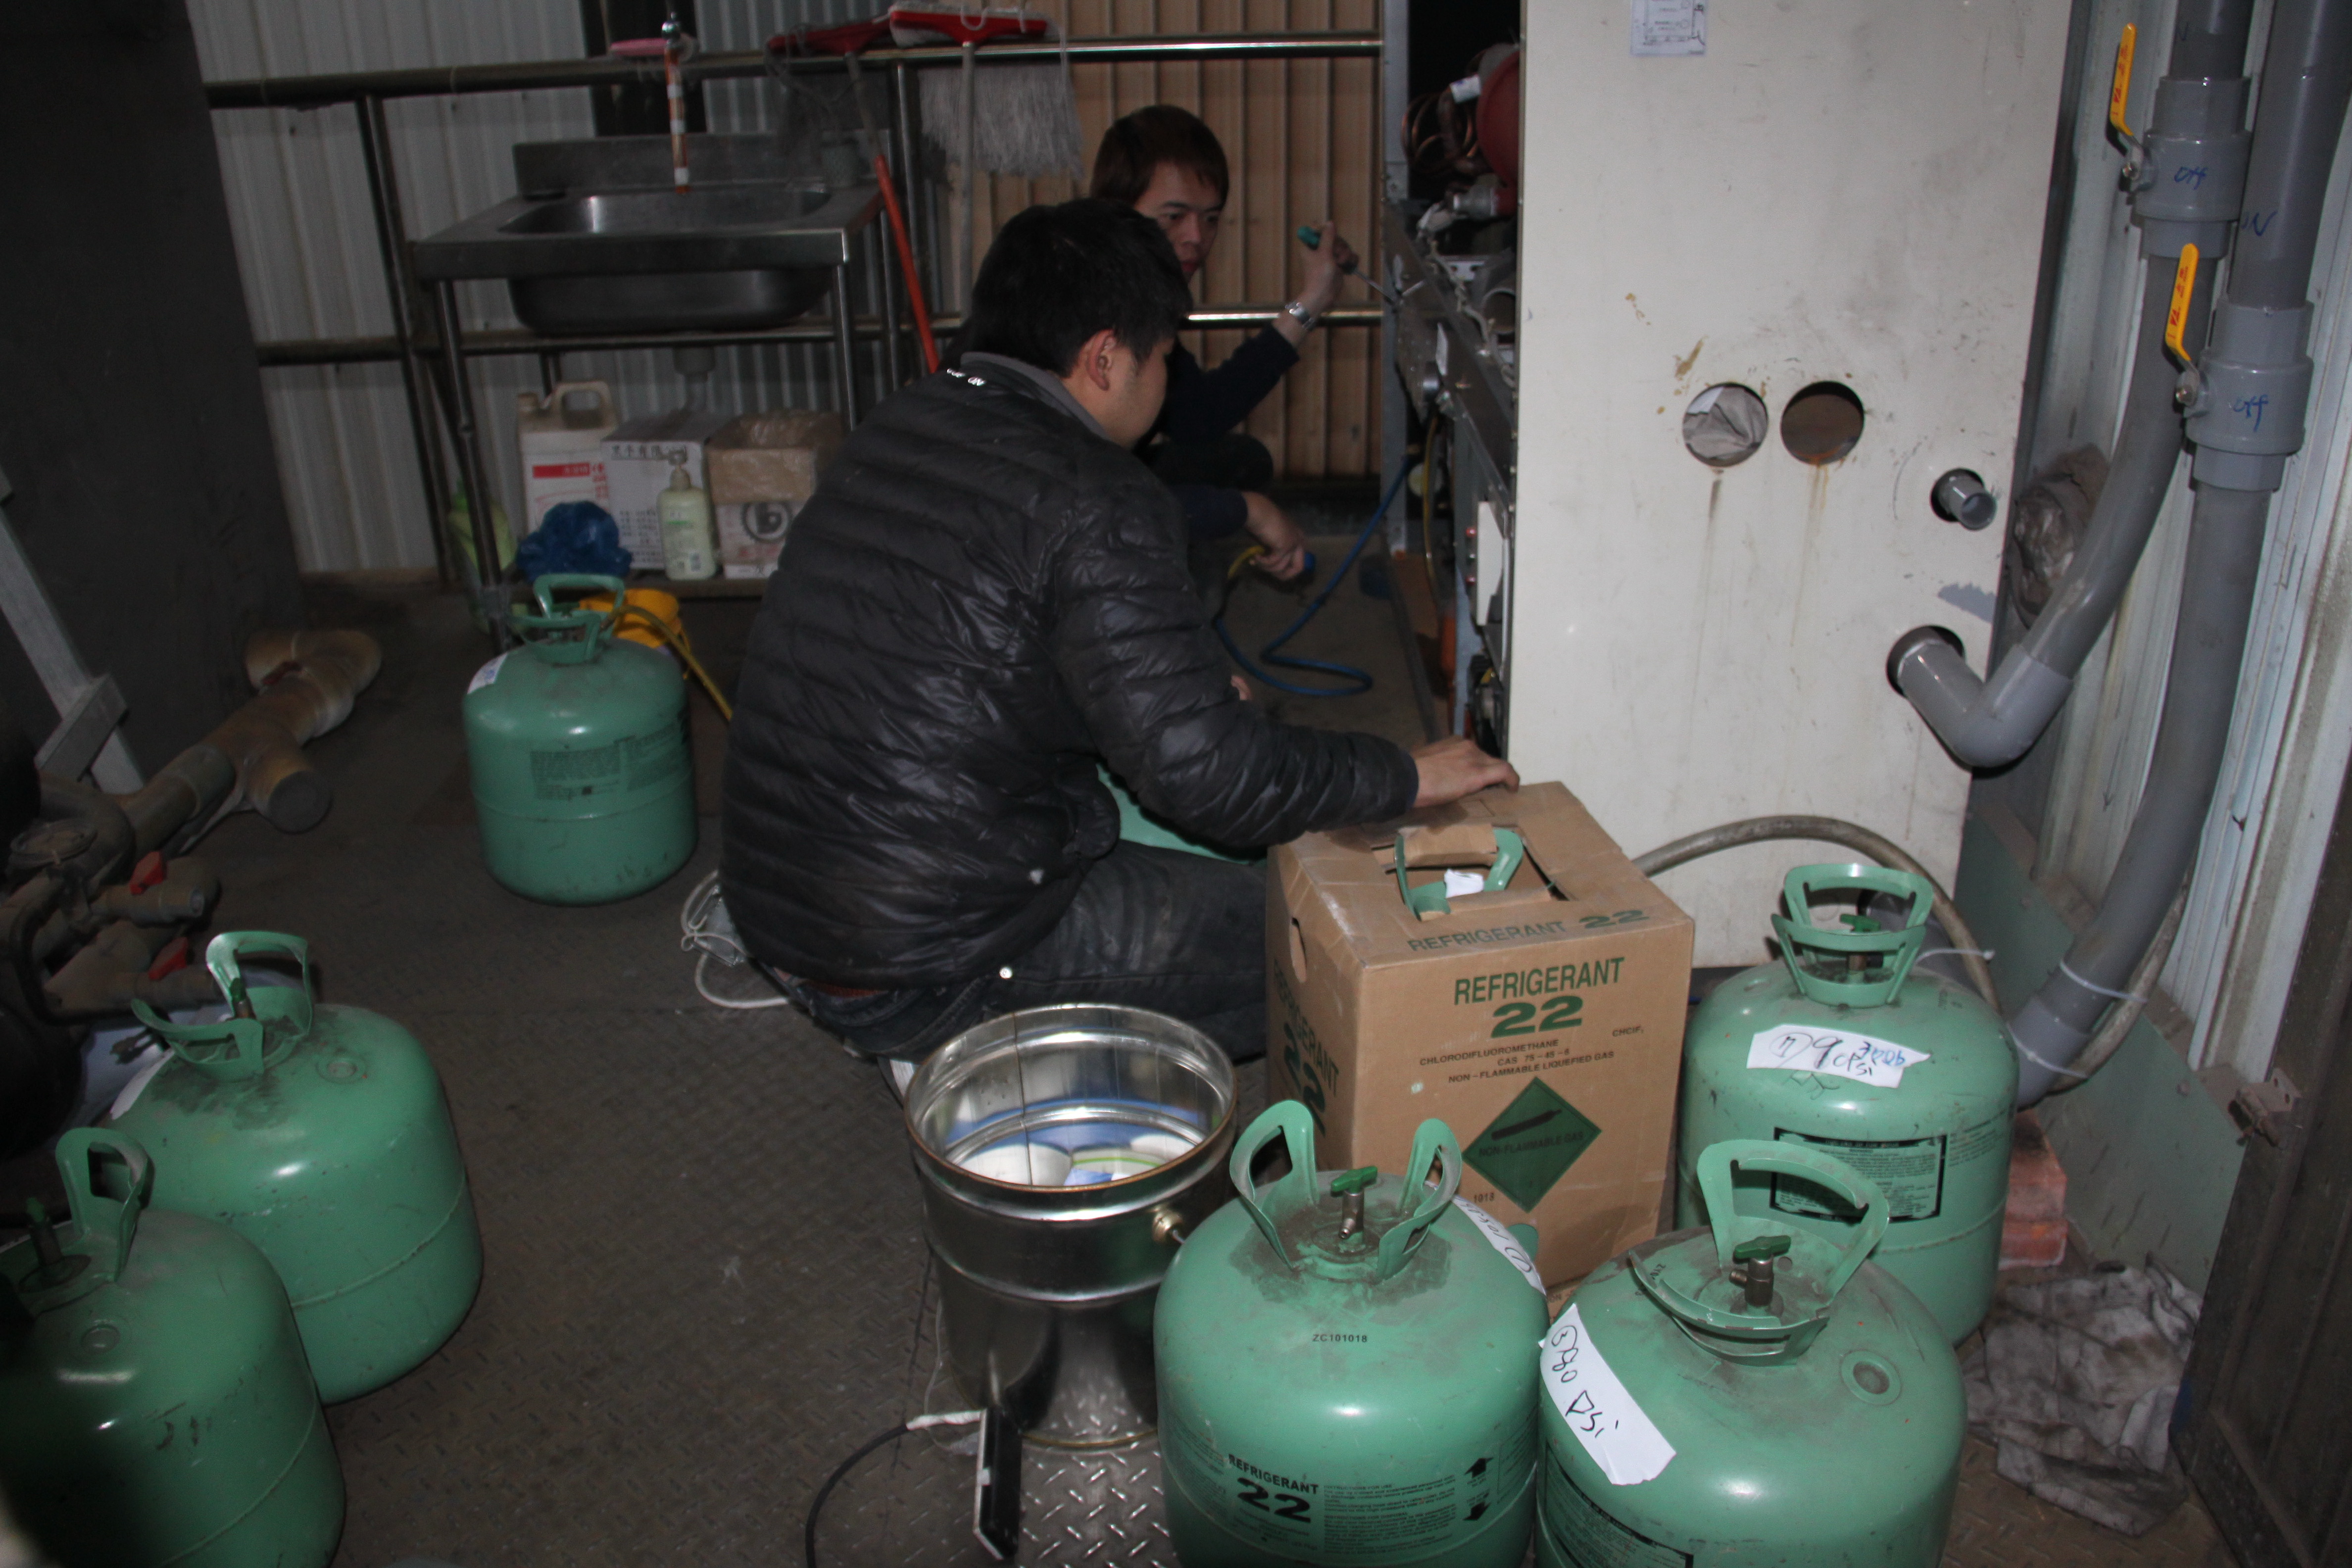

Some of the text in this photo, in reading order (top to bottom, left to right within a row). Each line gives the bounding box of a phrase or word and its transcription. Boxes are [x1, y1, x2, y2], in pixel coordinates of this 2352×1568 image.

[1407, 909, 1650, 952] REFRIGERANT 22
[1454, 957, 1625, 1005] REFRIGERANT
[1491, 995, 1583, 1038] 22
[1420, 1039, 1559, 1066] CHLORODIFLUOROMETHANE
[1497, 1057, 1518, 1066] CAS
[1543, 1055, 1592, 1070] LIQUEFIED
[1594, 1051, 1615, 1061] GAS
[1312, 1334, 1368, 1343] ZC101018
[1228, 1453, 1319, 1495] REFRIGERANT
[1238, 1477, 1311, 1523] 22
